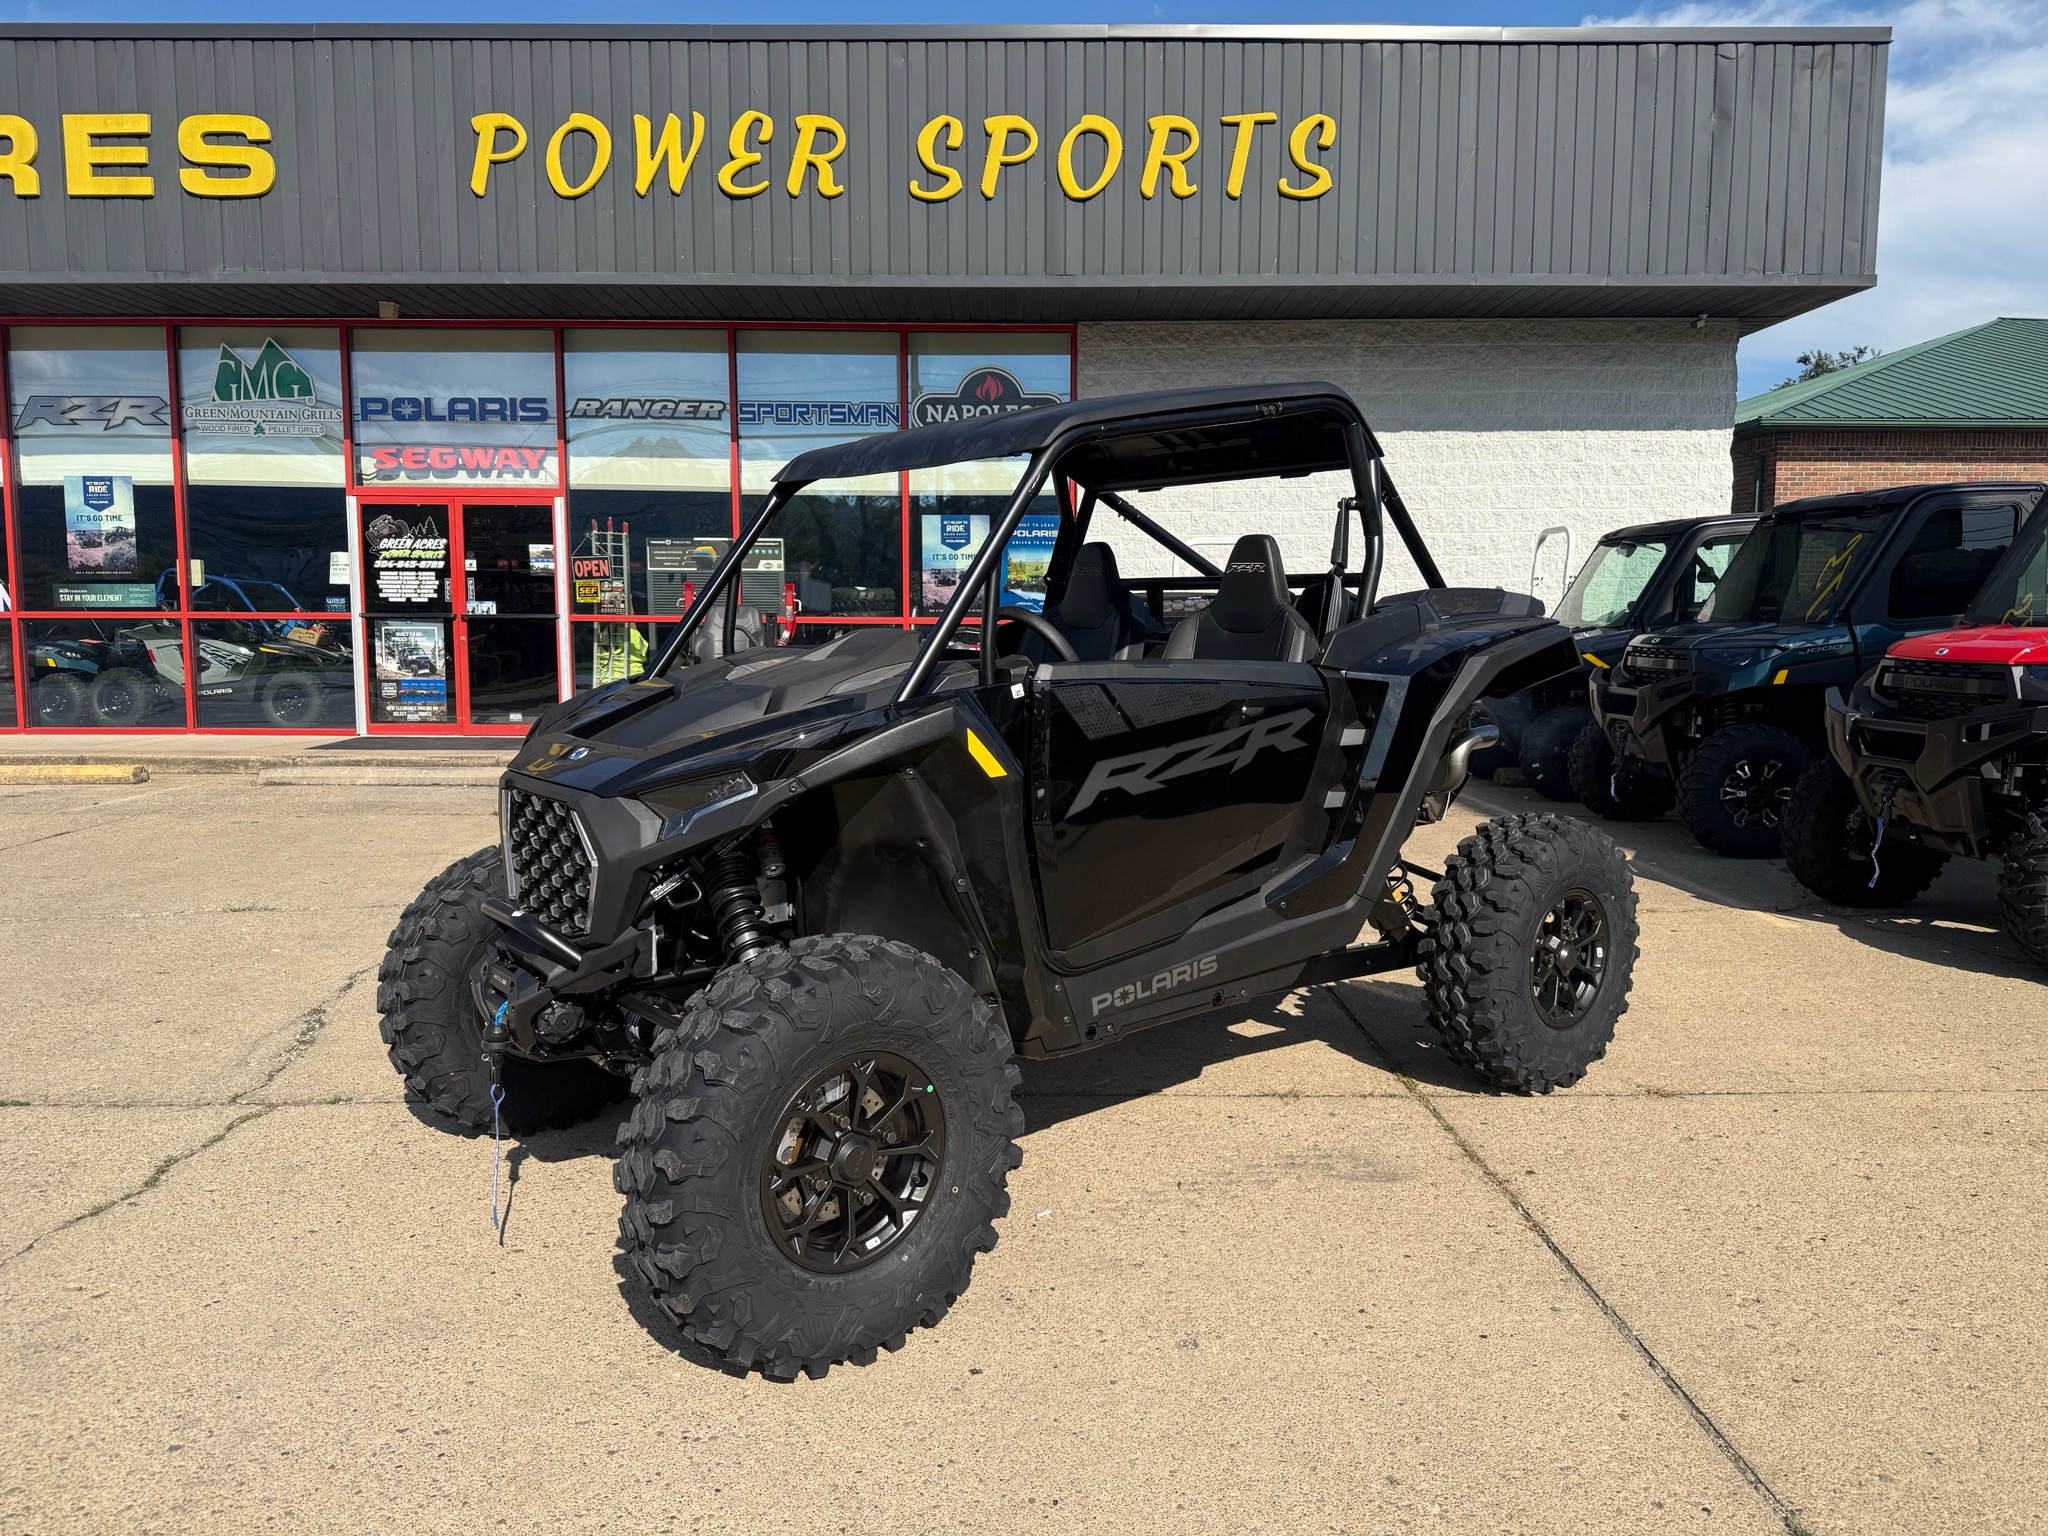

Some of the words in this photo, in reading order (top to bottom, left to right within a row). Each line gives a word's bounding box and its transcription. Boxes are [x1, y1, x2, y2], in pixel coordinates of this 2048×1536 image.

[471, 110, 846, 198] POWER
[909, 112, 1337, 200] SPORTS
[212, 359, 302, 403] GMG
[14, 396, 168, 431] RZR
[185, 408, 226, 419] GREEN
[229, 408, 298, 420] MOUNTAIN
[302, 409, 343, 420] GRILLS
[360, 397, 549, 422] POLARIS
[571, 398, 724, 420] RANGER
[738, 402, 901, 425] SPORTSMAN
[925, 405, 1040, 422] NAPOL
[372, 448, 547, 470] SEGWAY
[379, 549, 411, 560] POWER
[410, 550, 447, 559] SPORTS
[380, 538, 413, 549] GREEN
[412, 538, 448, 549] ACRES
[574, 560, 610, 577] OPEN
[1226, 562, 1265, 573] RZR
[59, 594, 73, 602] STAY
[74, 594, 81, 602] IN
[82, 594, 96, 602] YOUR
[97, 594, 122, 602] ELEMENT
[1803, 644, 1844, 653] 1000
[1064, 708, 1315, 820] RZR
[1091, 954, 1218, 1016] POLARIS
